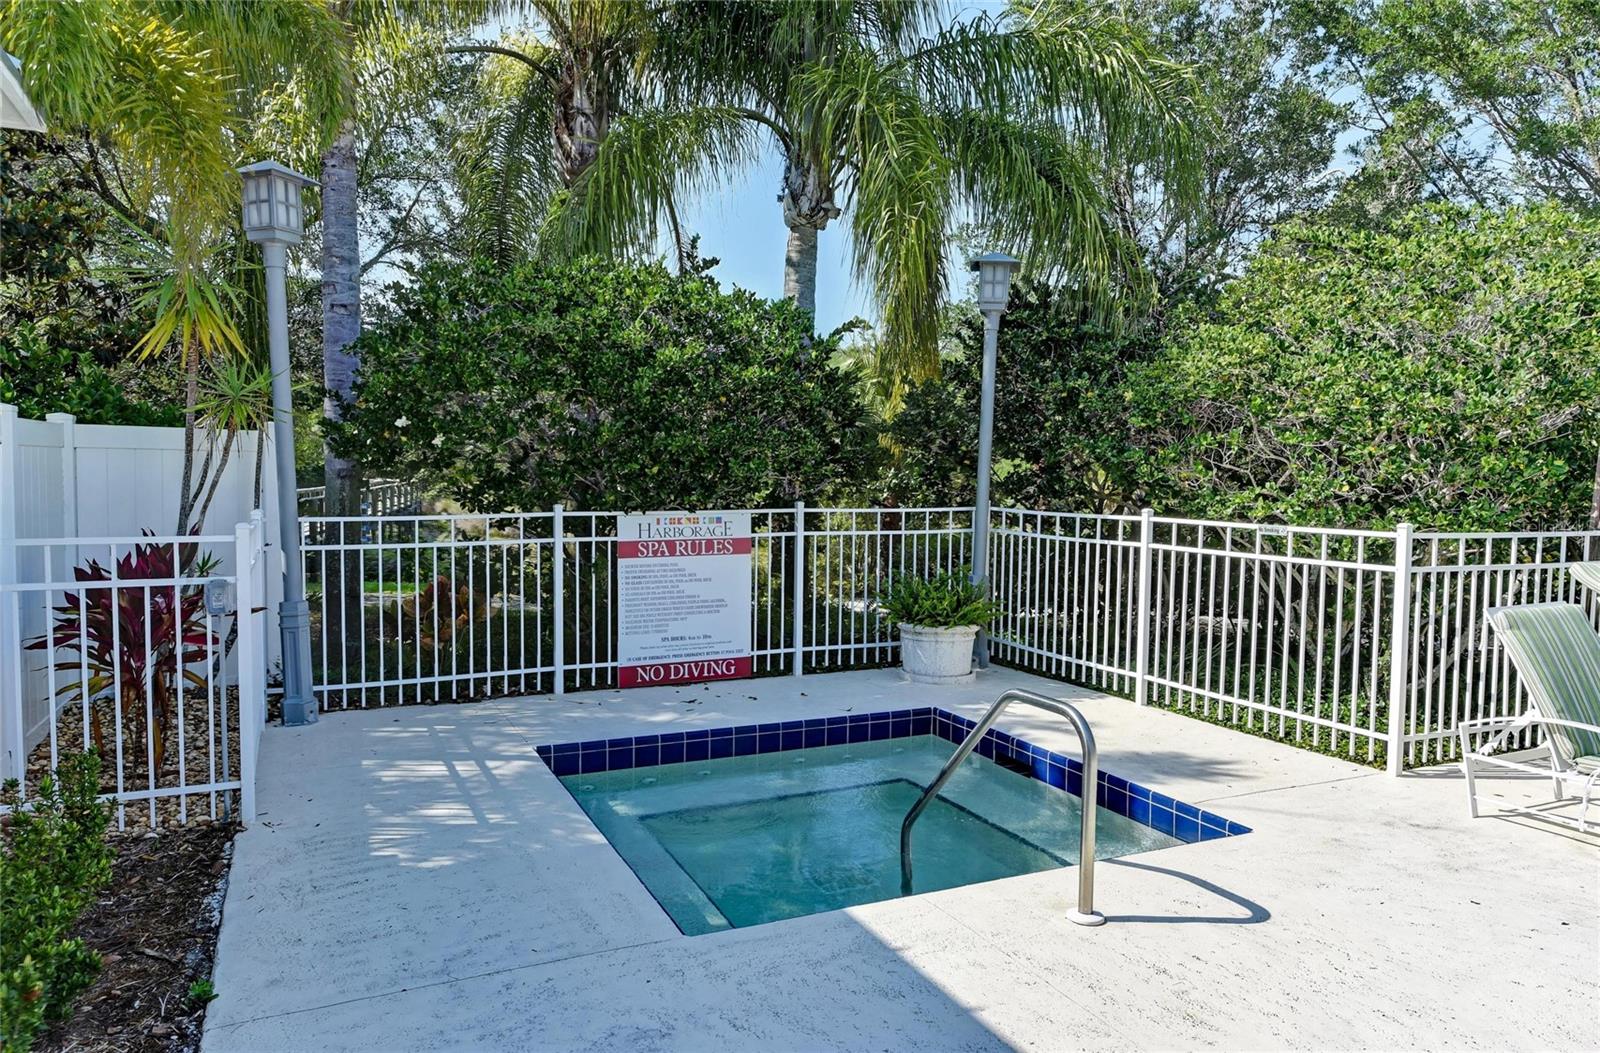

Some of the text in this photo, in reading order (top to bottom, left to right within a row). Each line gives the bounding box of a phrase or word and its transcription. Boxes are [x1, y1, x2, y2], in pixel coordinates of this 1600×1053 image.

[638, 521, 733, 539] HARBORAGE
[638, 539, 734, 557] SPA RULES
[636, 659, 736, 683] NO DIVING
